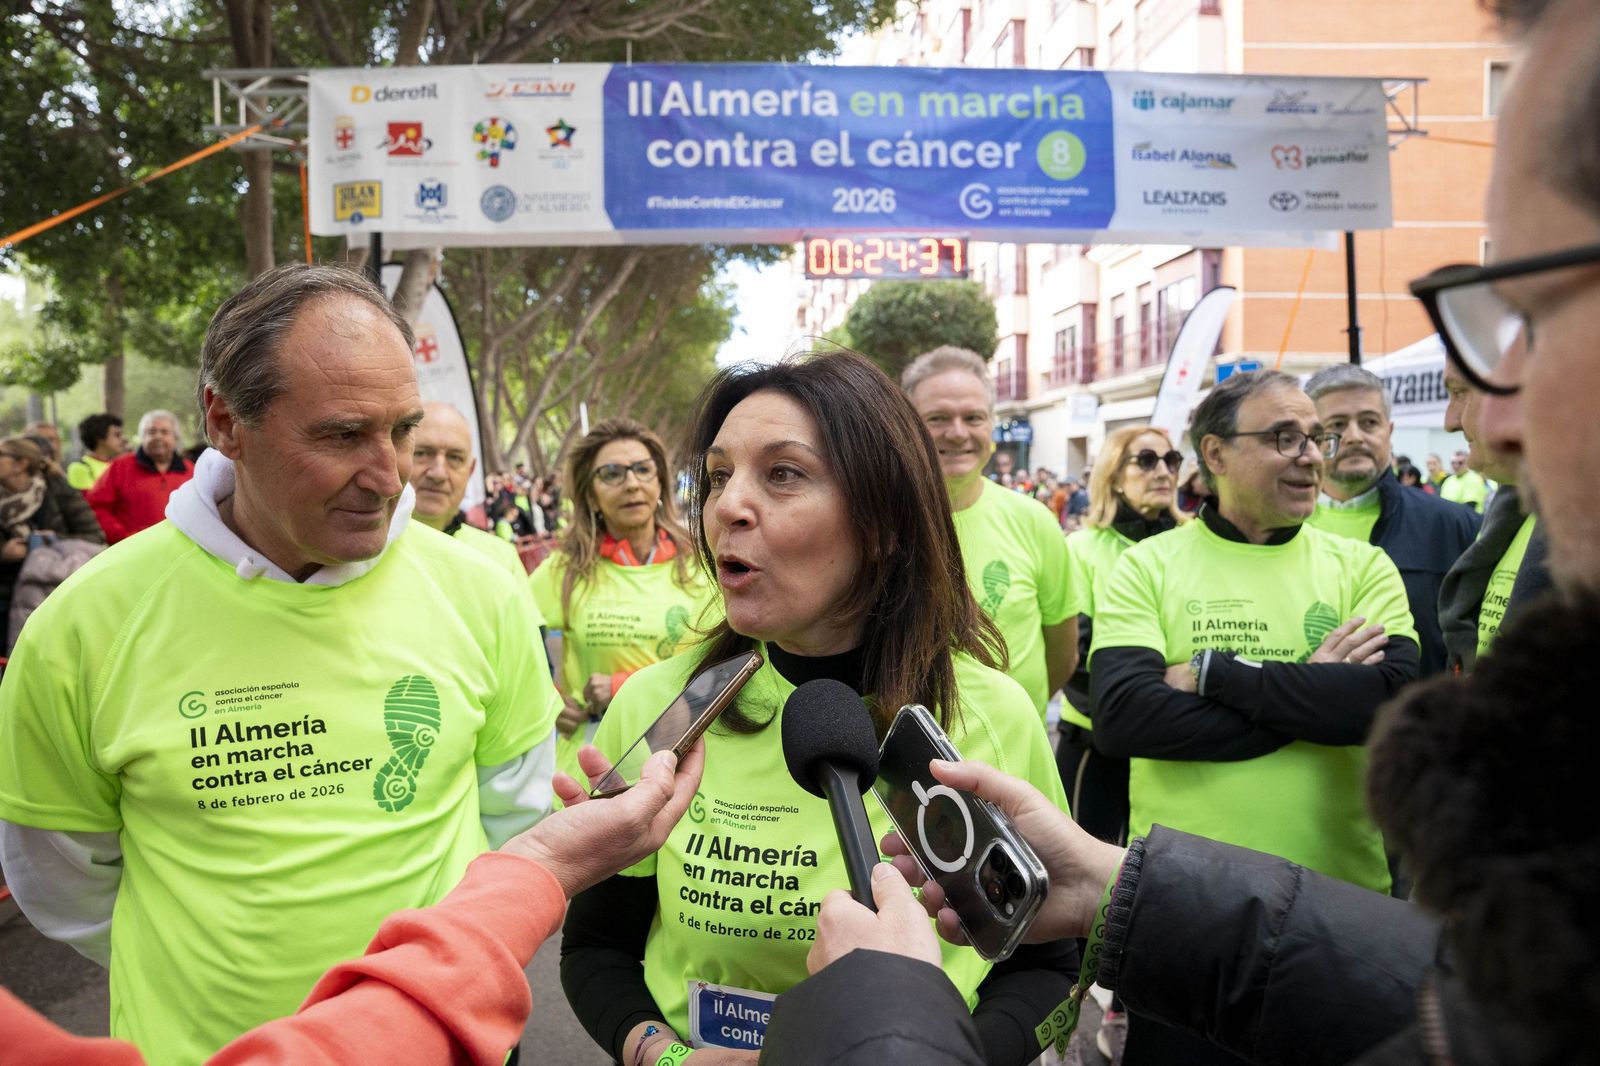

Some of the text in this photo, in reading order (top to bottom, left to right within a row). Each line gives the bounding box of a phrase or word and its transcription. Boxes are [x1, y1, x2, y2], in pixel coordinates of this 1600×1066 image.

[375, 84, 438, 101] deretil
[628, 80, 1086, 120] II Almería en marcha
[1161, 92, 1236, 113] cajamar
[646, 130, 1022, 168] contra el cáncer
[1052, 138, 1071, 165] 8
[1132, 148, 1232, 163] Isabel Alonso
[832, 187, 897, 214] 2026
[1142, 190, 1227, 206] LEALTADIS
[1305, 190, 1340, 200] Toyota
[808, 238, 962, 275] 00:24:37
[1192, 618, 1269, 632] II Almería
[1192, 633, 1260, 644] en marcha
[1250, 645, 1296, 657] cáncer
[214, 681, 300, 697] asociación española
[215, 691, 283, 706] contra el cáncer
[227, 702, 262, 714] Almería
[190, 715, 327, 749] II Almería
[191, 741, 314, 769] en marcha
[191, 756, 373, 791] contra el cáncer
[198, 783, 345, 810] 8 de febrero de 2026
[714, 798, 799, 814] asociación española
[710, 816, 757, 831] en Almería
[712, 807, 780, 823] contra el cáncer
[685, 833, 818, 867] II Almería
[683, 862, 799, 890] en marcha
[679, 886, 744, 913] contra
[750, 895, 774, 915] el
[679, 911, 685, 923] 8
[687, 916, 701, 930] de
[705, 920, 758, 938] febrero
[763, 927, 782, 940] de
[714, 999, 723, 1015] II
